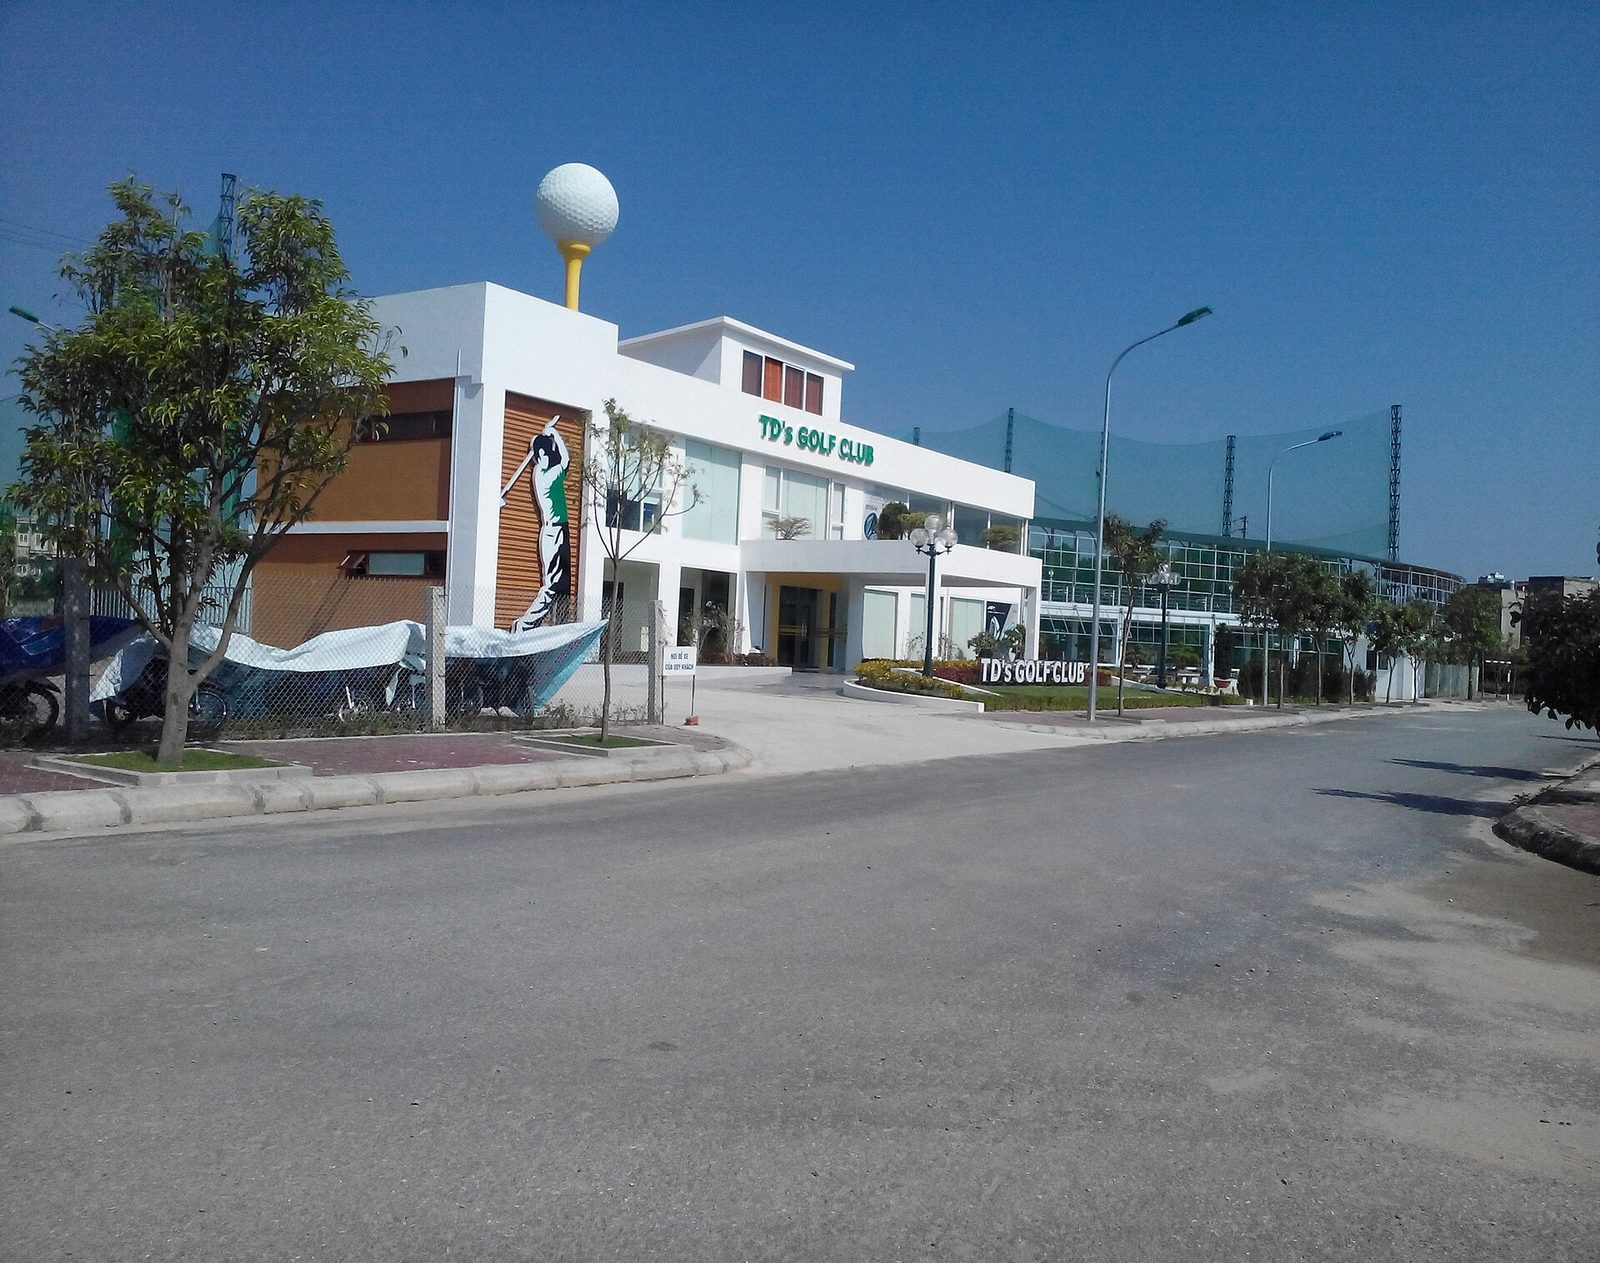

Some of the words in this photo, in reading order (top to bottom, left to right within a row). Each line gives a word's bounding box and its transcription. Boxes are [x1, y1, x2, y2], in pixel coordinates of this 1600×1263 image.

[758, 414, 793, 446] TD's
[796, 426, 836, 456] GOLF
[838, 438, 875, 466] CLUB
[981, 658, 1012, 683] TD's
[1015, 660, 1051, 683] GOLF
[1053, 661, 1085, 683] CLUB
